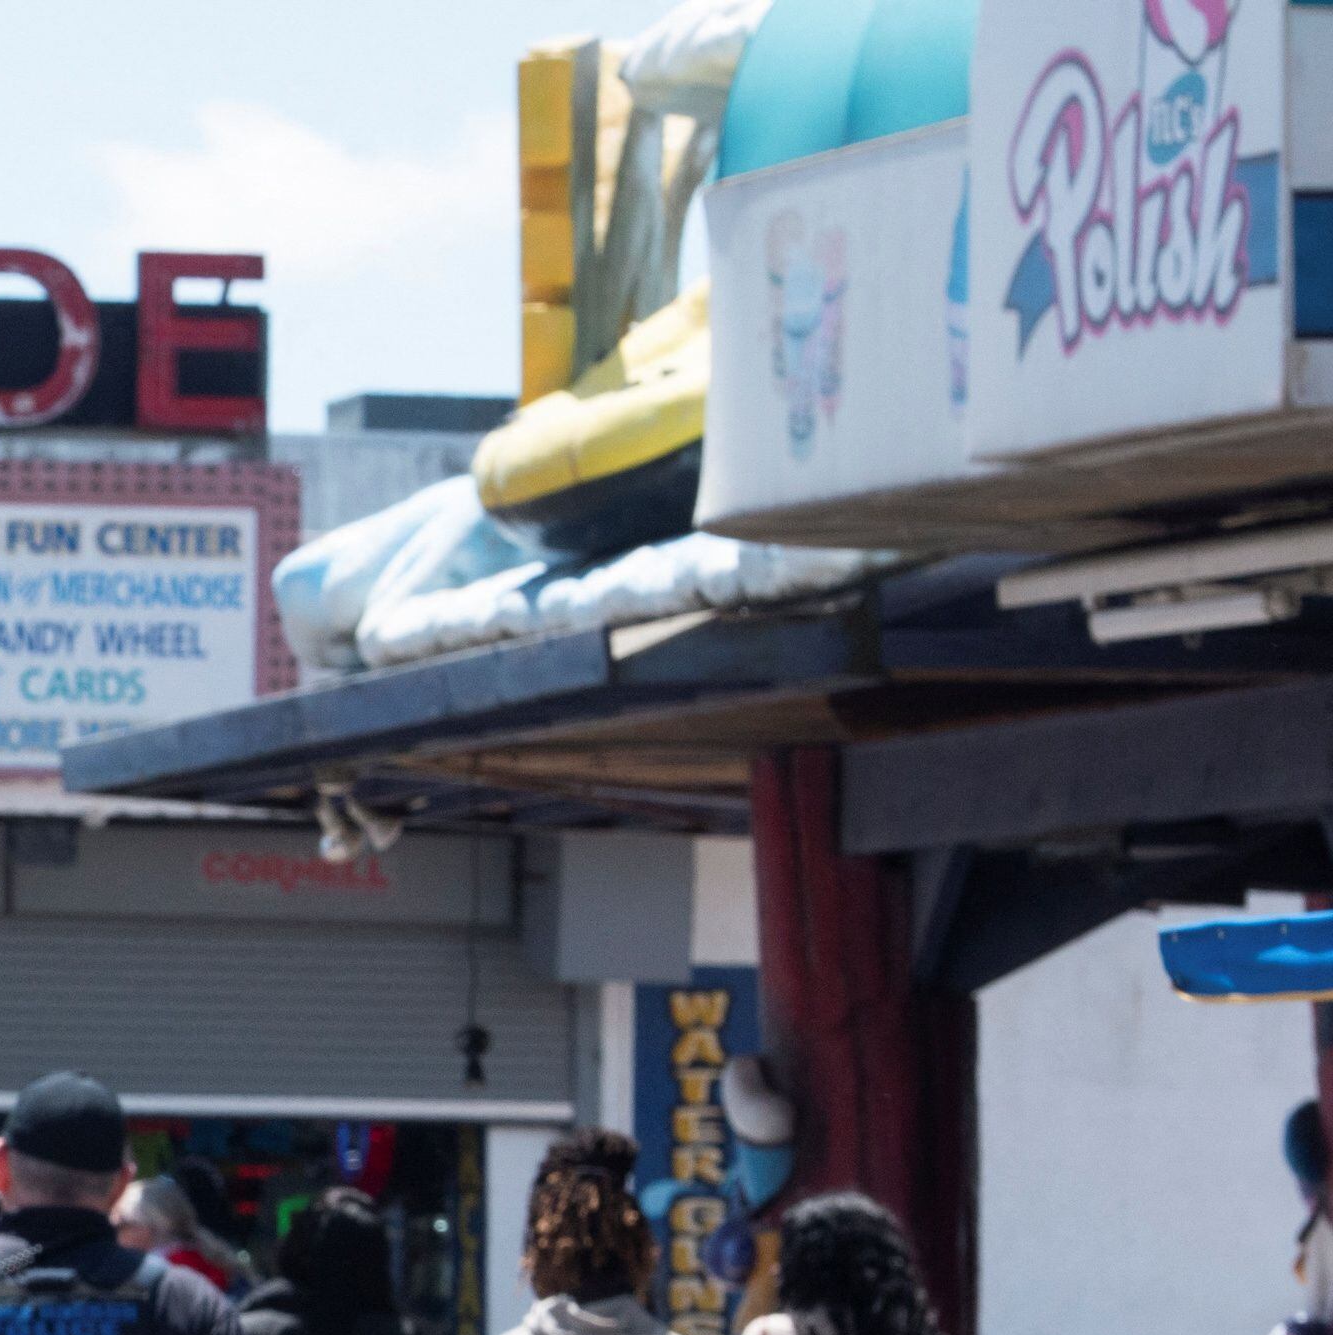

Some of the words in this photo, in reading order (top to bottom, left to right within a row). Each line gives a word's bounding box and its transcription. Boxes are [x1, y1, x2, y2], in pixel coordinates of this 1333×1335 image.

[1010, 49, 1250, 354] Polish
[4, 522, 80, 555] FUN
[96, 523, 242, 558] CENTER
[49, 571, 244, 609] MERCHANDISE
[92, 622, 208, 659] WHEEL
[18, 668, 147, 705] CARDS
[668, 990, 730, 1187] WATER
